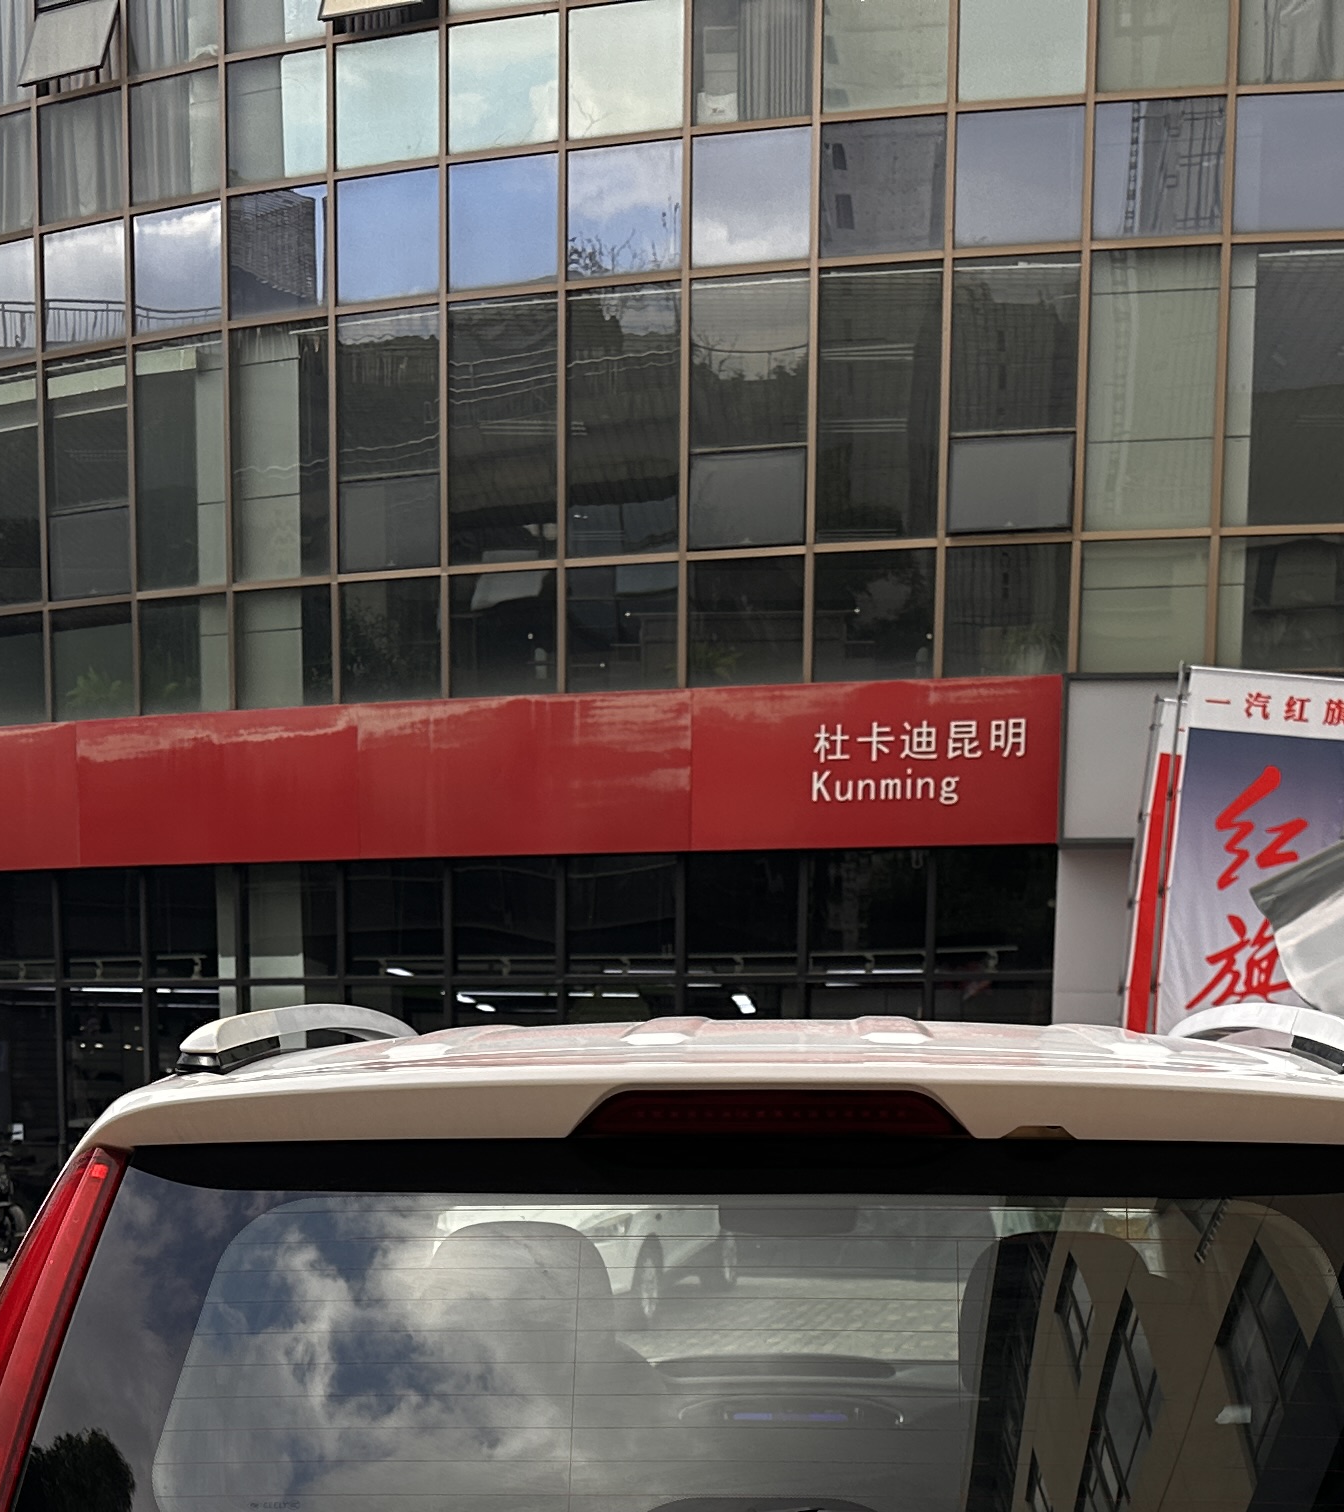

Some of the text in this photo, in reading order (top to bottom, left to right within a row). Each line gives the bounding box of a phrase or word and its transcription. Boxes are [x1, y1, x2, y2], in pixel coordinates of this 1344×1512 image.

[812, 717, 1027, 764] 杜卡迪昆明
[811, 767, 960, 805] Kunming
